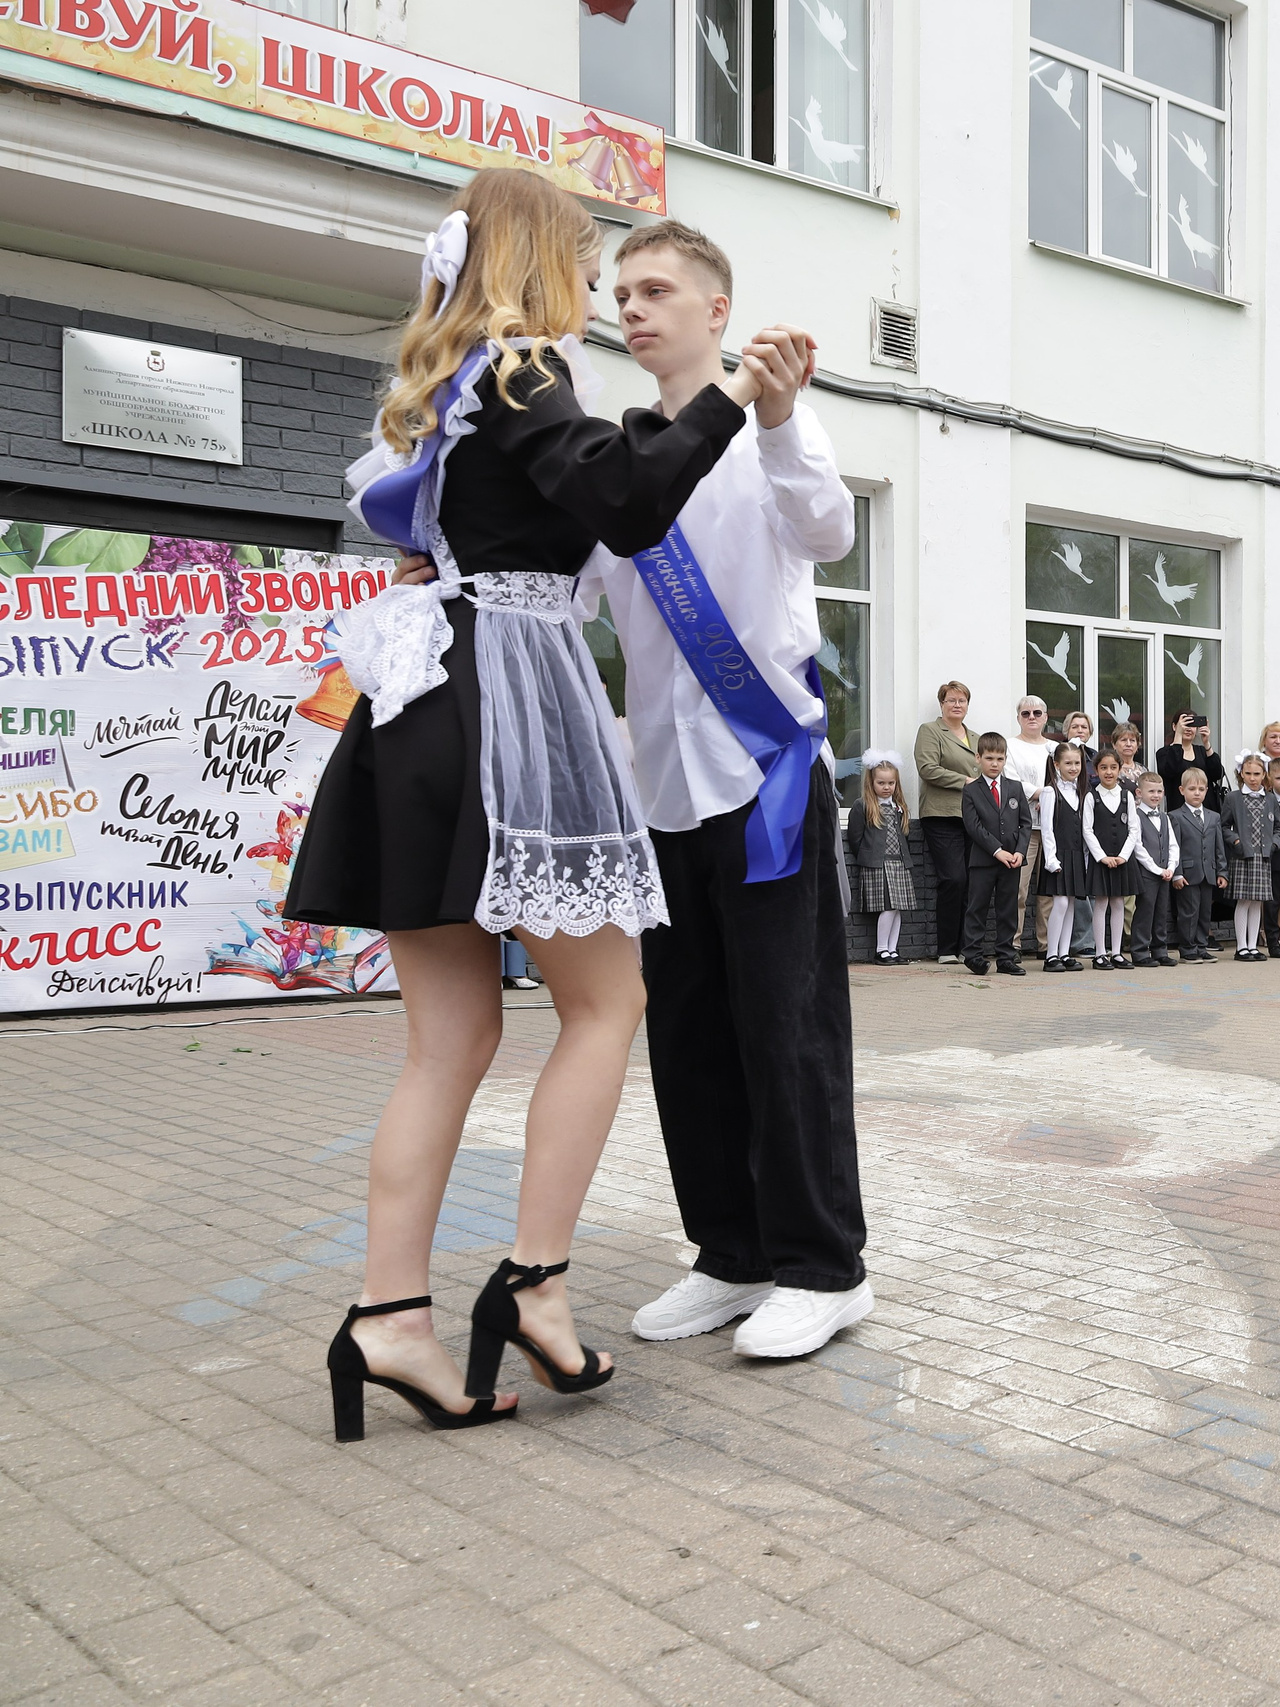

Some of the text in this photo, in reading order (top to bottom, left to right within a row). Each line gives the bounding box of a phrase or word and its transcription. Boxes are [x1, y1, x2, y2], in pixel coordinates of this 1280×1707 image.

[0, 0, 551, 163] ВУЙ, ШКОЛА!
[83, 365, 235, 395] Администрация города Нижнего Новгорода
[115, 377, 206, 397] Департамент образования
[83, 388, 226, 416] МУНИЦИПАЛЬНОЕ БЮДЖЕТНОЕ
[99, 399, 211, 421] ОБЩЕОБРАЗОВАТЕЛЬНОЕ
[125, 411, 187, 425] УЧРЕЖДЕНИЕ
[81, 422, 227, 452] «ШКОЛА № 75»
[200, 626, 327, 670] 2025
[693, 623, 757, 690] 2025
[1, 706, 76, 737] ЕЛЯ!
[194, 680, 297, 732] Делай
[84, 707, 184, 749] Мечтай
[201, 756, 287, 795] лучше
[119, 773, 240, 840] Сегодня
[100, 820, 165, 847] твой
[46, 955, 202, 1005] Действуй!
